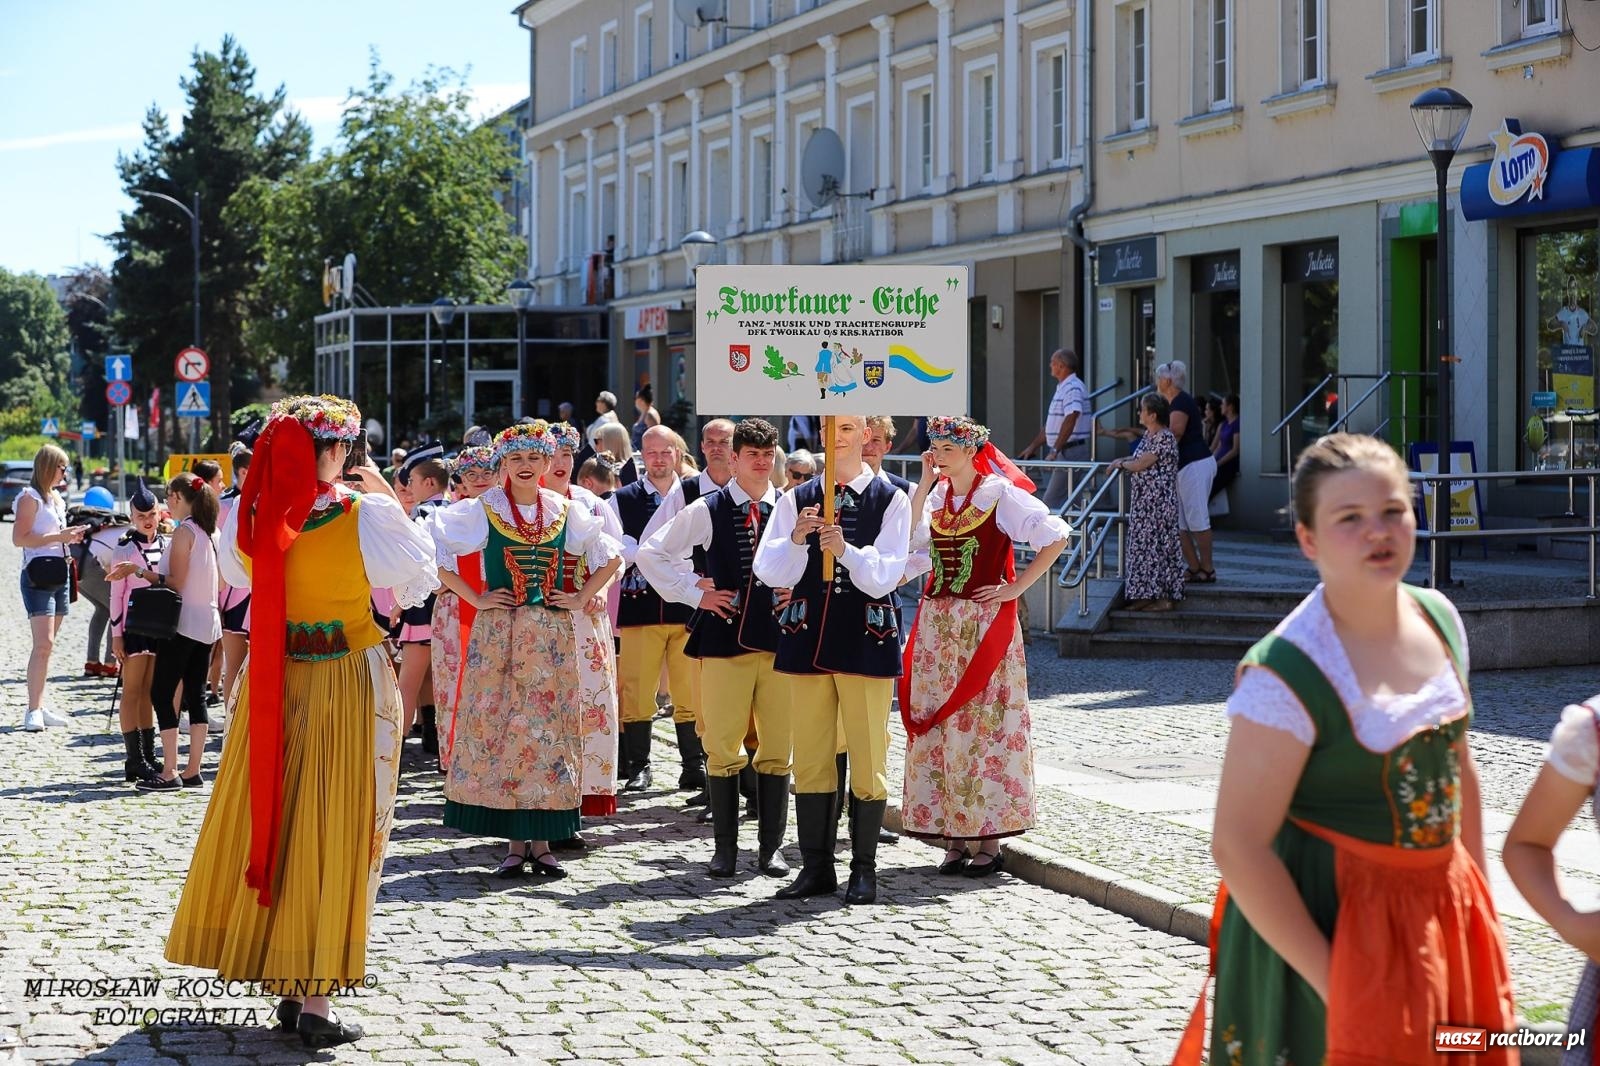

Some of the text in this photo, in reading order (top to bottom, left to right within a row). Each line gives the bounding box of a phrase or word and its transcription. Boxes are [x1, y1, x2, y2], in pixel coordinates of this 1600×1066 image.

[1501, 148, 1535, 189] LOTTO
[1113, 245, 1142, 277] Juliette
[1211, 261, 1238, 287] Juliette
[1305, 249, 1335, 277] Juliette
[835, 321, 927, 329] TRACHTENGRUPPE
